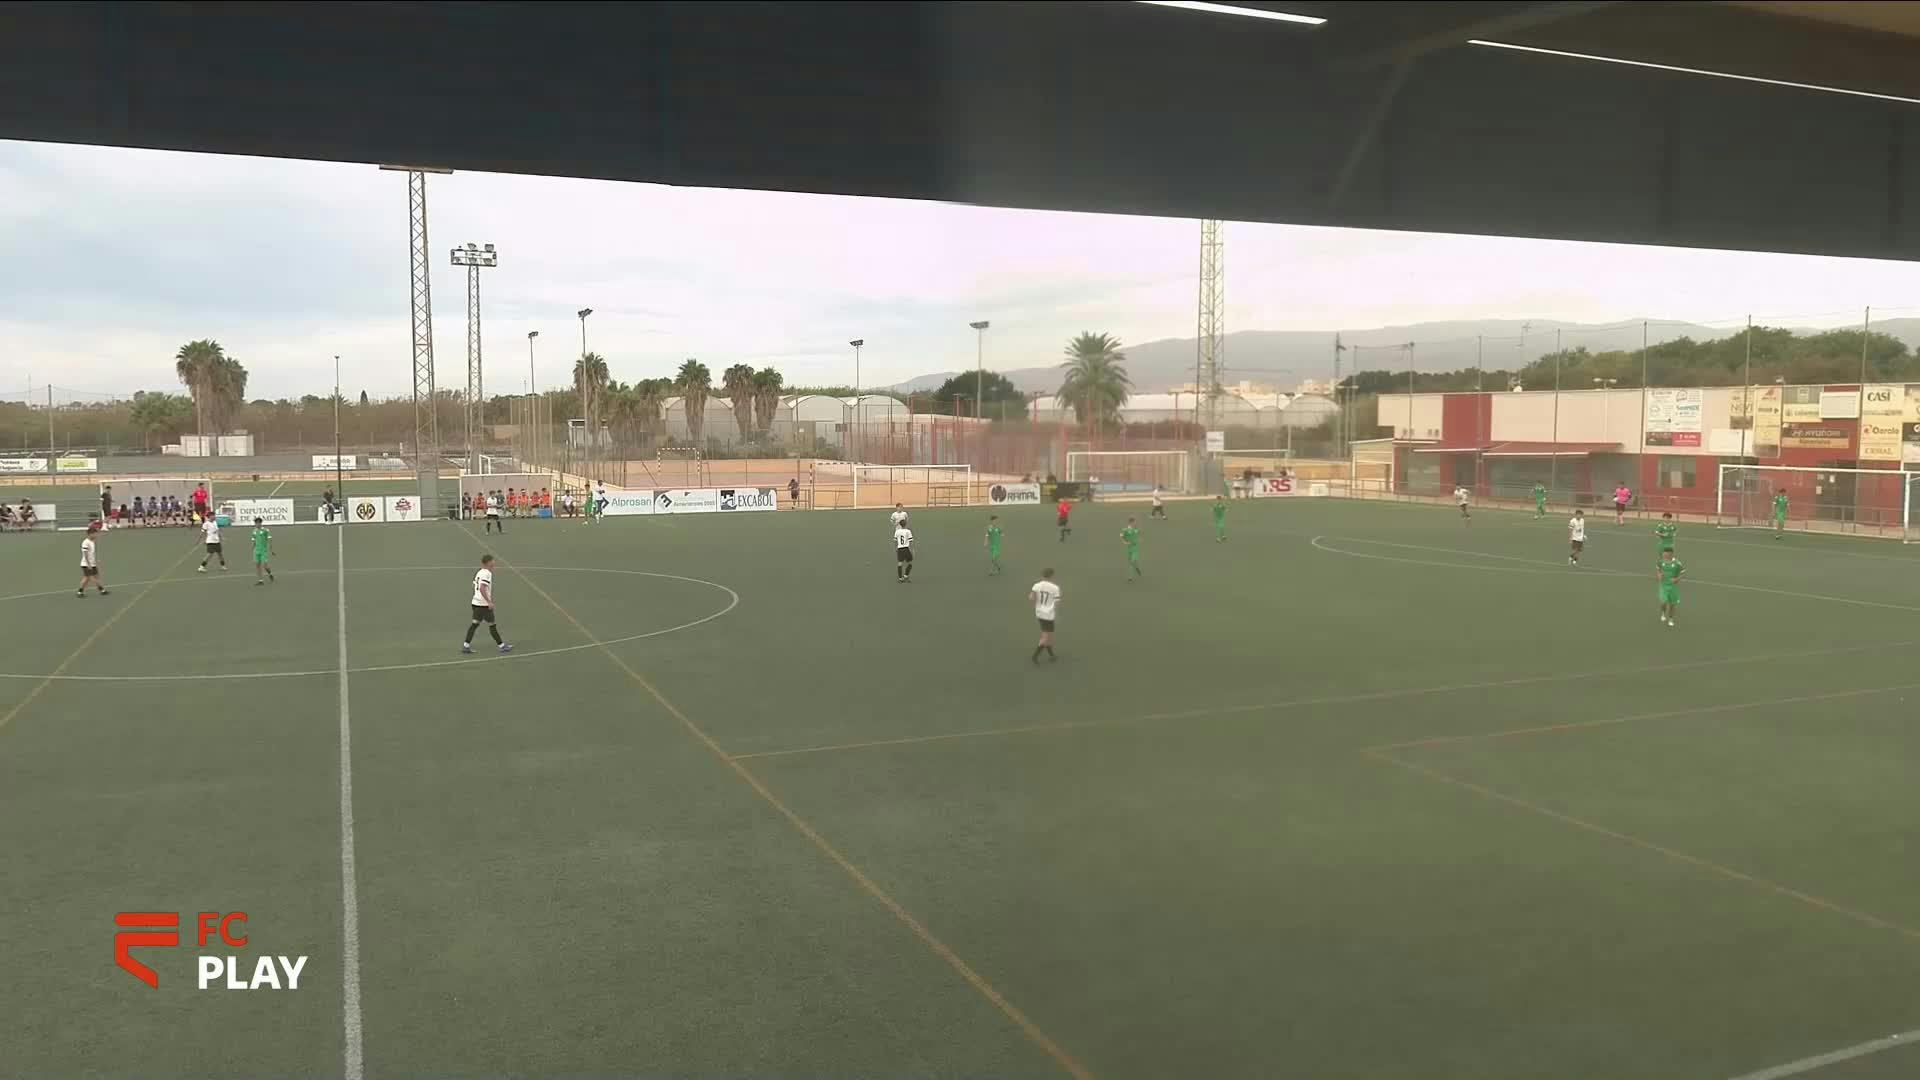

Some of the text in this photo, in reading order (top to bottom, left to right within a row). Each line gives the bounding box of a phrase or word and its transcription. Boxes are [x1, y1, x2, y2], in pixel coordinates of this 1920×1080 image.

[611, 497, 652, 509] Alprosan
[738, 494, 773, 507] EXCABOL
[1040, 591, 1049, 605] 17
